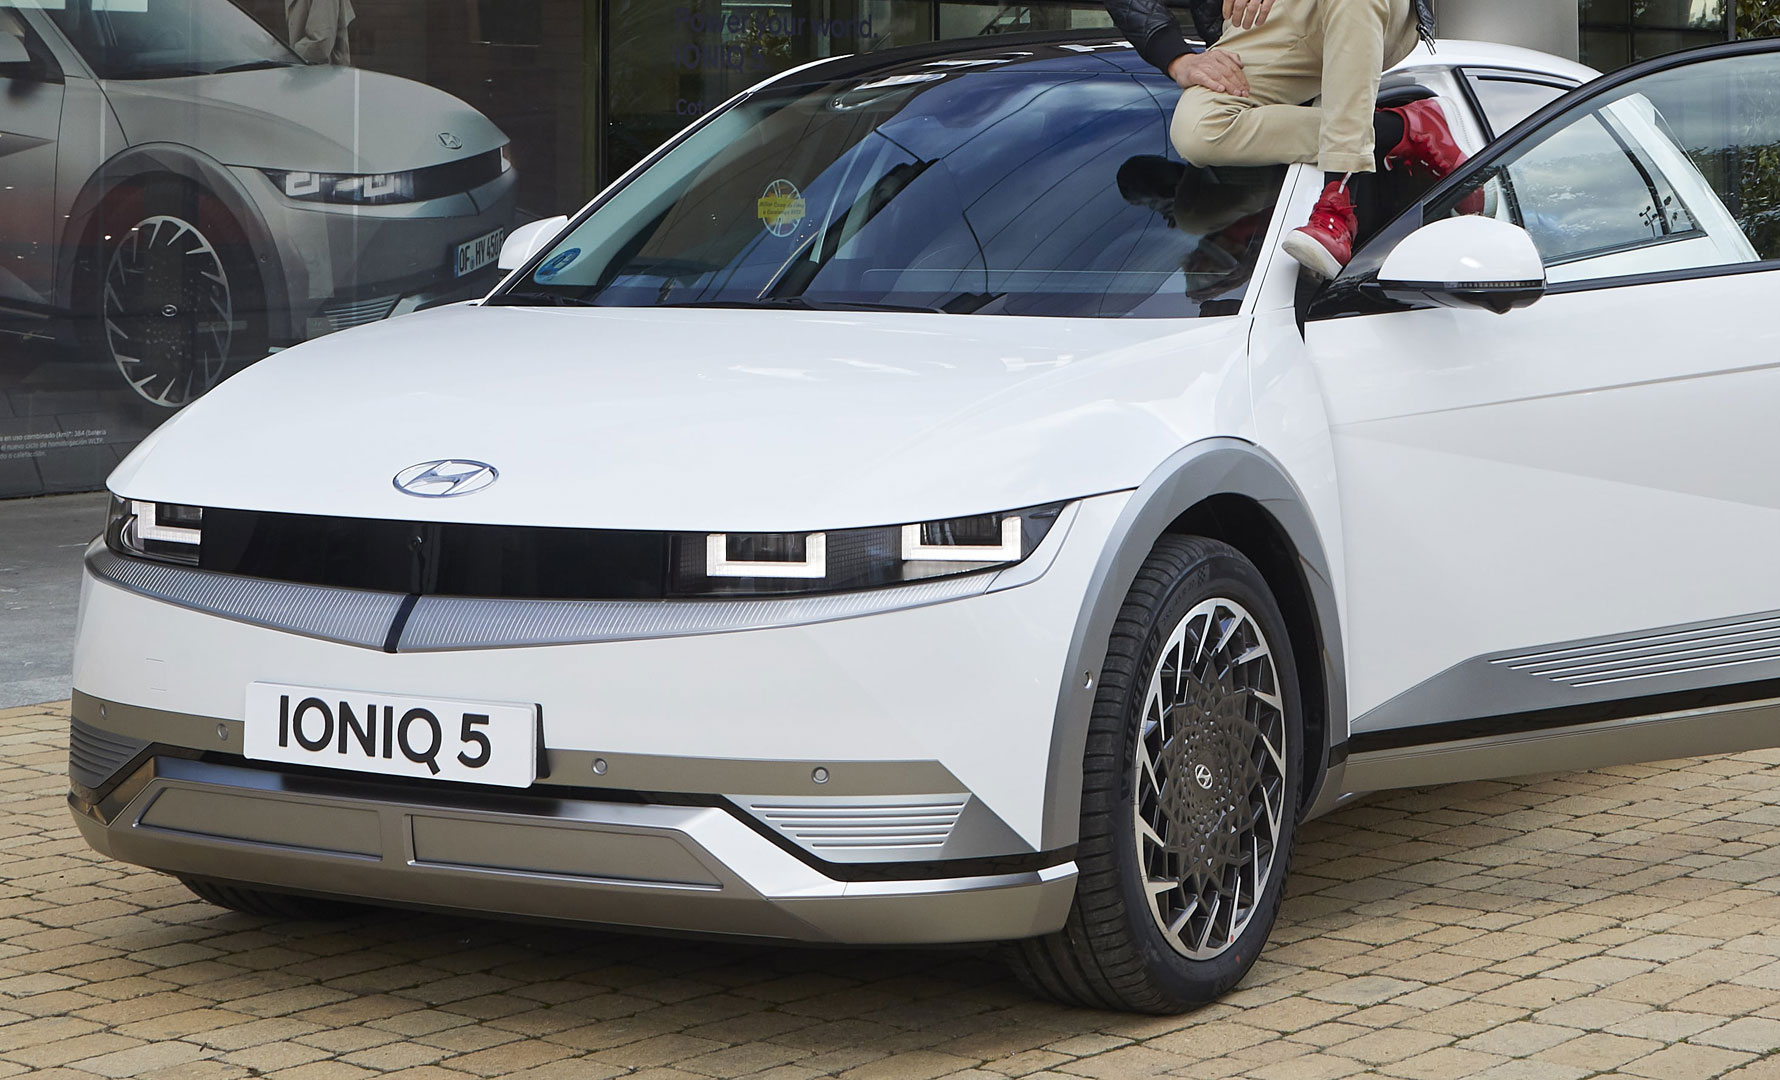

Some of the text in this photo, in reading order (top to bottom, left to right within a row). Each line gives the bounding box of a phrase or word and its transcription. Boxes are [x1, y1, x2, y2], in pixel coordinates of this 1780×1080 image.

[674, 6, 879, 40] Power your world.
[674, 41, 745, 74] IONIQ
[459, 245, 471, 273] OF
[475, 238, 487, 267] HY
[278, 694, 492, 776] IONIQ 5
